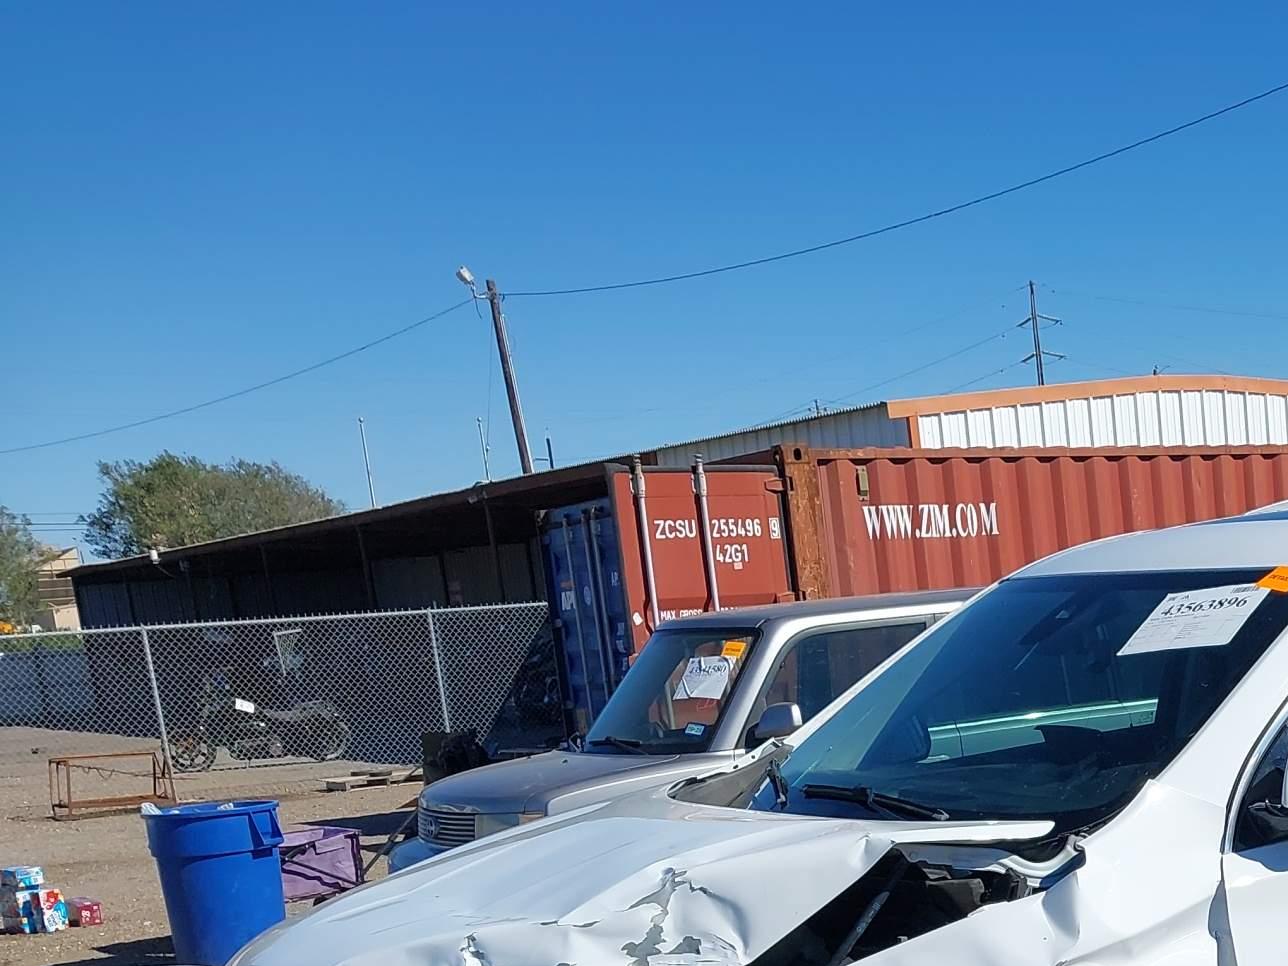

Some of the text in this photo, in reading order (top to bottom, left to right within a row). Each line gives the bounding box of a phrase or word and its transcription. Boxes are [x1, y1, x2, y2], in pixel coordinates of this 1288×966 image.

[654, 518, 780, 539] ZCSU 255496 9
[862, 502, 1000, 540] WWW.ZIM.COM
[716, 544, 749, 563] 42G1
[660, 610, 676, 621] MAX
[1161, 596, 1249, 617] 43563896
